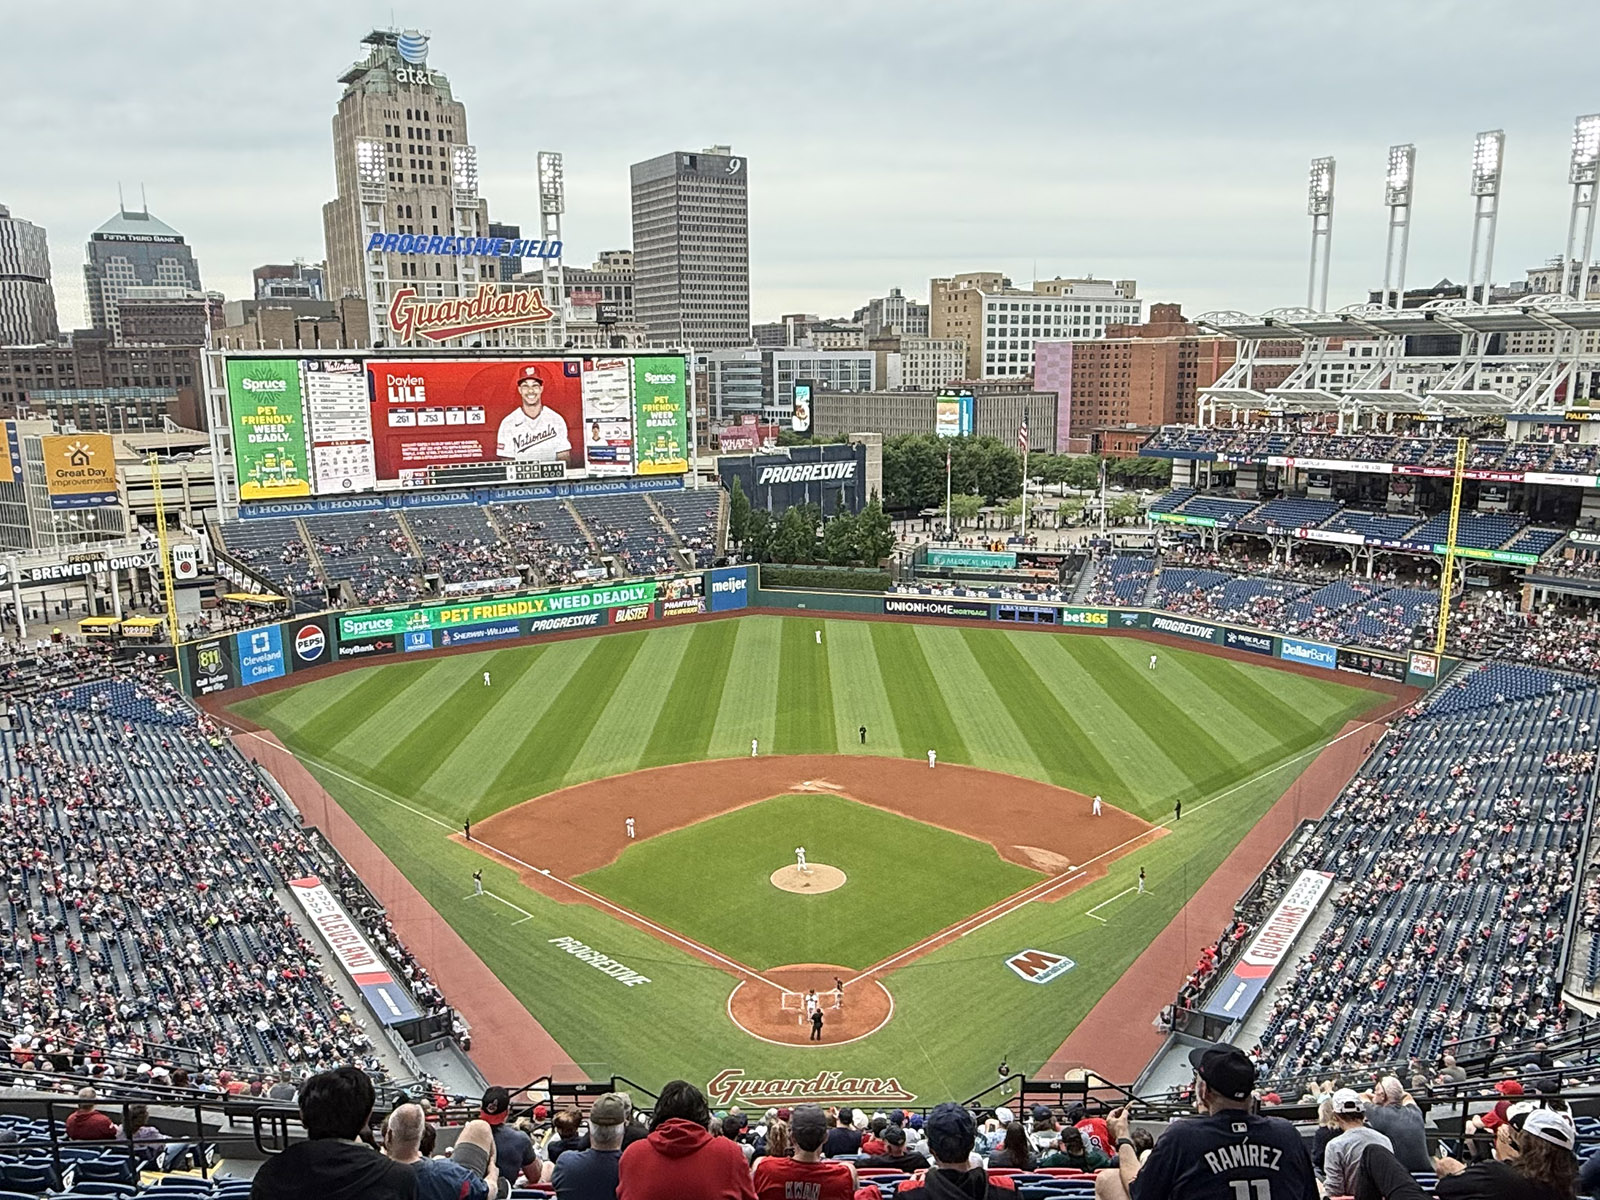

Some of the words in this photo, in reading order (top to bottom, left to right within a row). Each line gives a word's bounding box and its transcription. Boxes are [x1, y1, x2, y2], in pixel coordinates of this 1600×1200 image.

[396, 66, 435, 86] at&t
[725, 158, 741, 175] 9
[367, 233, 506, 257] PROGRESSIVE
[510, 239, 563, 259] FIELD
[388, 283, 554, 345] Guardians
[242, 378, 287, 392] Spruce
[387, 374, 424, 387] Daylen
[645, 373, 676, 384] Spruce
[388, 386, 426, 402] LILE
[654, 396, 669, 404] PET
[257, 406, 278, 415] PET
[642, 402, 681, 412] FRIENDLY.
[241, 415, 296, 425] FRIENDLY.
[651, 411, 673, 419] WEED
[253, 424, 285, 433] WEED
[646, 419, 678, 427] DEADLY.
[248, 433, 293, 443] DEADLY.
[513, 424, 557, 449] Nationals
[56, 469, 86, 478] Great
[87, 467, 107, 478] Day
[759, 462, 857, 485] PROGRESSIVE
[585, 482, 627, 492] HONDA
[640, 479, 679, 489] HONDA
[421, 493, 469, 503] HONDA
[507, 488, 551, 497] HONDA
[259, 503, 315, 514] HONDA
[331, 498, 383, 511] HONDA
[69, 552, 105, 562] PROUDLY
[175, 549, 194, 560] Lite
[32, 562, 90, 580] BREWED
[94, 561, 108, 573] IN
[110, 556, 141, 570] OHIO
[982, 560, 1014, 568] MUTUAL
[712, 577, 746, 593] meijer
[440, 608, 470, 623] PET
[473, 600, 547, 619] FRIENDLY.
[549, 594, 590, 611] WEED
[592, 587, 648, 606] DEADLY.
[664, 599, 699, 610] PHANTOM
[615, 607, 648, 623] BLASTER
[1063, 610, 1108, 624] bet365
[343, 618, 394, 635] Spruce
[531, 613, 599, 631] PROGRESSIVE
[1152, 617, 1215, 639] PROGRESSIVE
[298, 637, 323, 649] PEPSI
[1238, 634, 1252, 643] PARK
[1252, 637, 1271, 647] PLACE
[339, 644, 375, 655] KeyBank
[201, 650, 218, 667] 811
[243, 650, 281, 666] Cleveland
[1413, 654, 1431, 667] drug
[252, 664, 274, 676] Clinic
[196, 678, 208, 687] Call
[209, 674, 228, 683] before
[1251, 905, 1307, 960] GUARDIANS
[317, 913, 375, 968] CLEVELAND
[548, 936, 652, 987] PROGRESSIVE
[707, 1069, 918, 1107] Guardians
[1204, 1136, 1282, 1175] RAMÍREZ
[785, 1181, 821, 1200] KWAN
